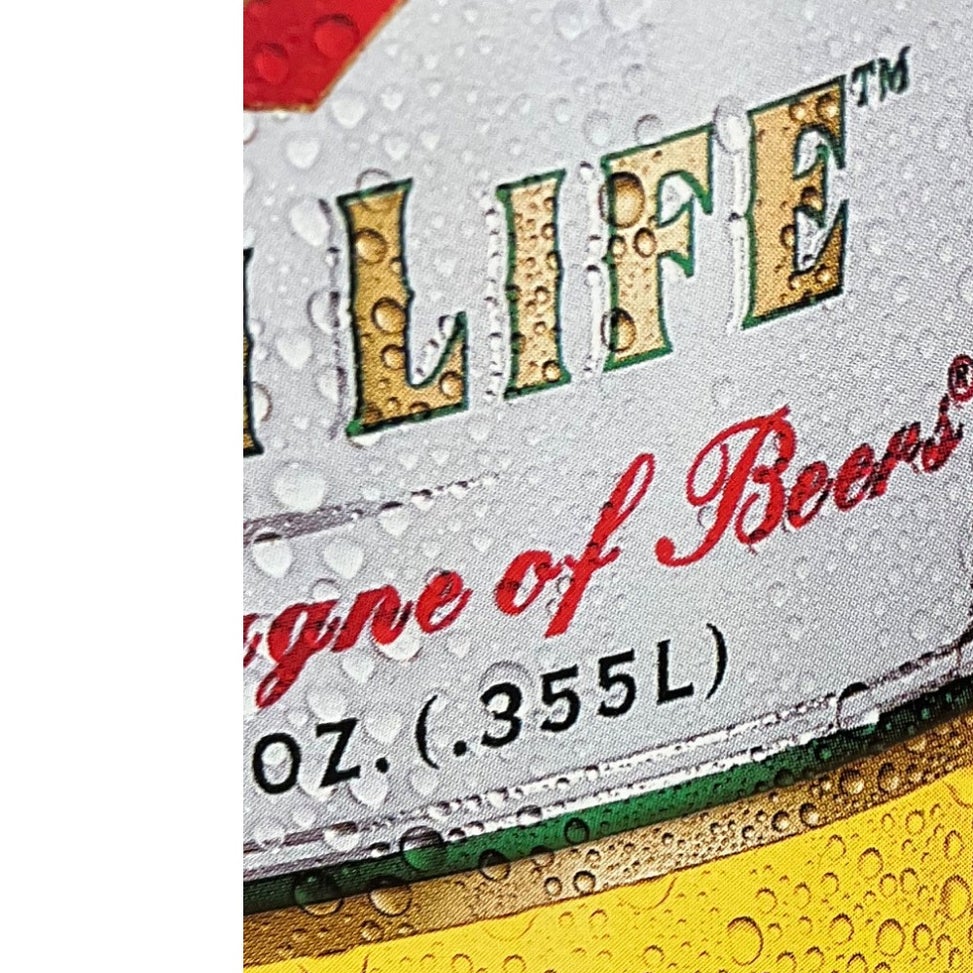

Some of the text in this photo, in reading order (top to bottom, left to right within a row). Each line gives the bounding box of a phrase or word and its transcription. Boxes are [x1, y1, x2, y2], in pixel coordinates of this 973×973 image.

[493, 451, 656, 639] of
[251, 622, 732, 796] OZ. (.355L)
